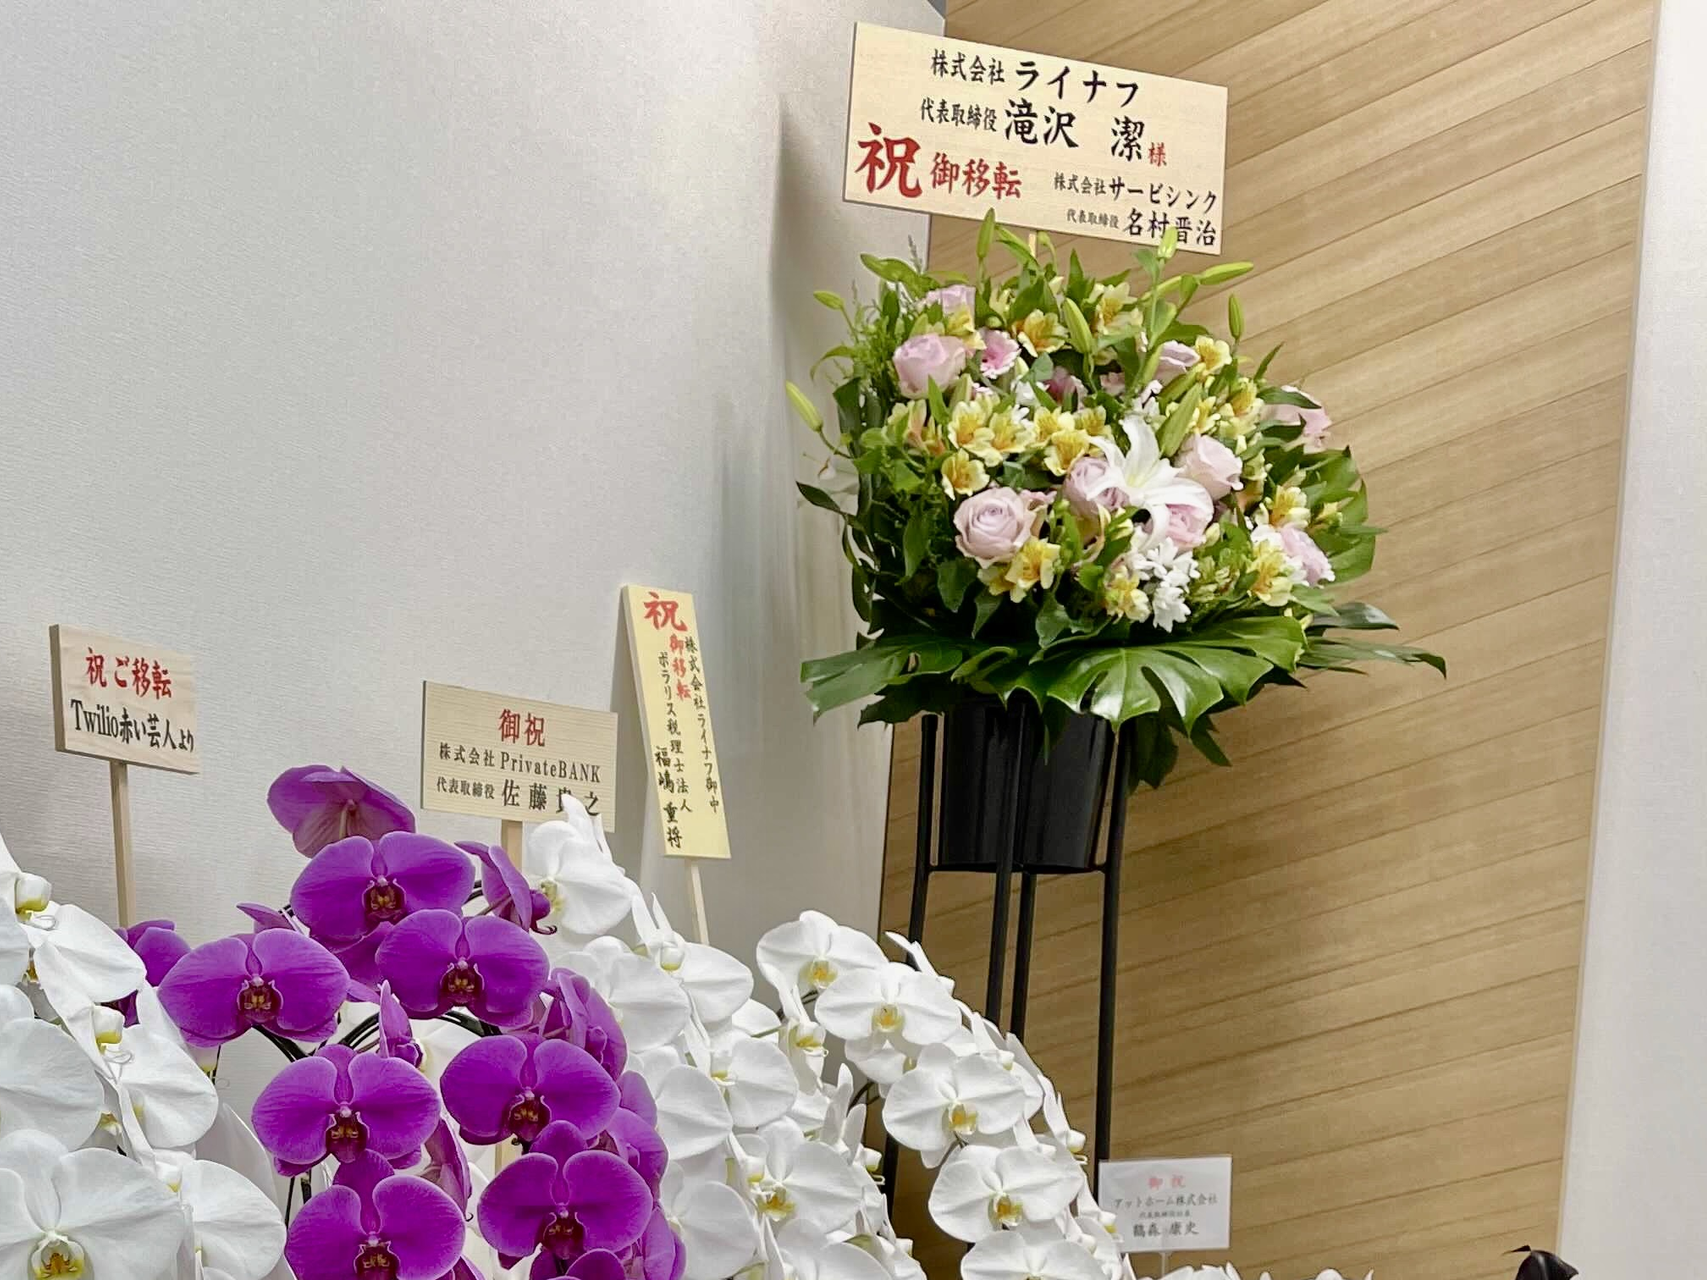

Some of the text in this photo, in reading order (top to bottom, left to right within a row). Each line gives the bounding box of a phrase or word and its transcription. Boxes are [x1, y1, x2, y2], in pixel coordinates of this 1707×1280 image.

[930, 48, 1139, 107] 株式会社 ライナフ
[920, 97, 1167, 167] 代表取締役 滝沢 潔 様
[855, 122, 1022, 199] 祝 御移転
[1066, 209, 1119, 229] 代表取締役
[644, 591, 688, 632] 祝
[669, 634, 692, 701] 御移転
[71, 699, 194, 752] Twilio赤い芸人より
[498, 709, 546, 747] 御祝
[439, 742, 601, 783] 株式会社 PrivateBANK
[436, 776, 495, 799] 代表取締役
